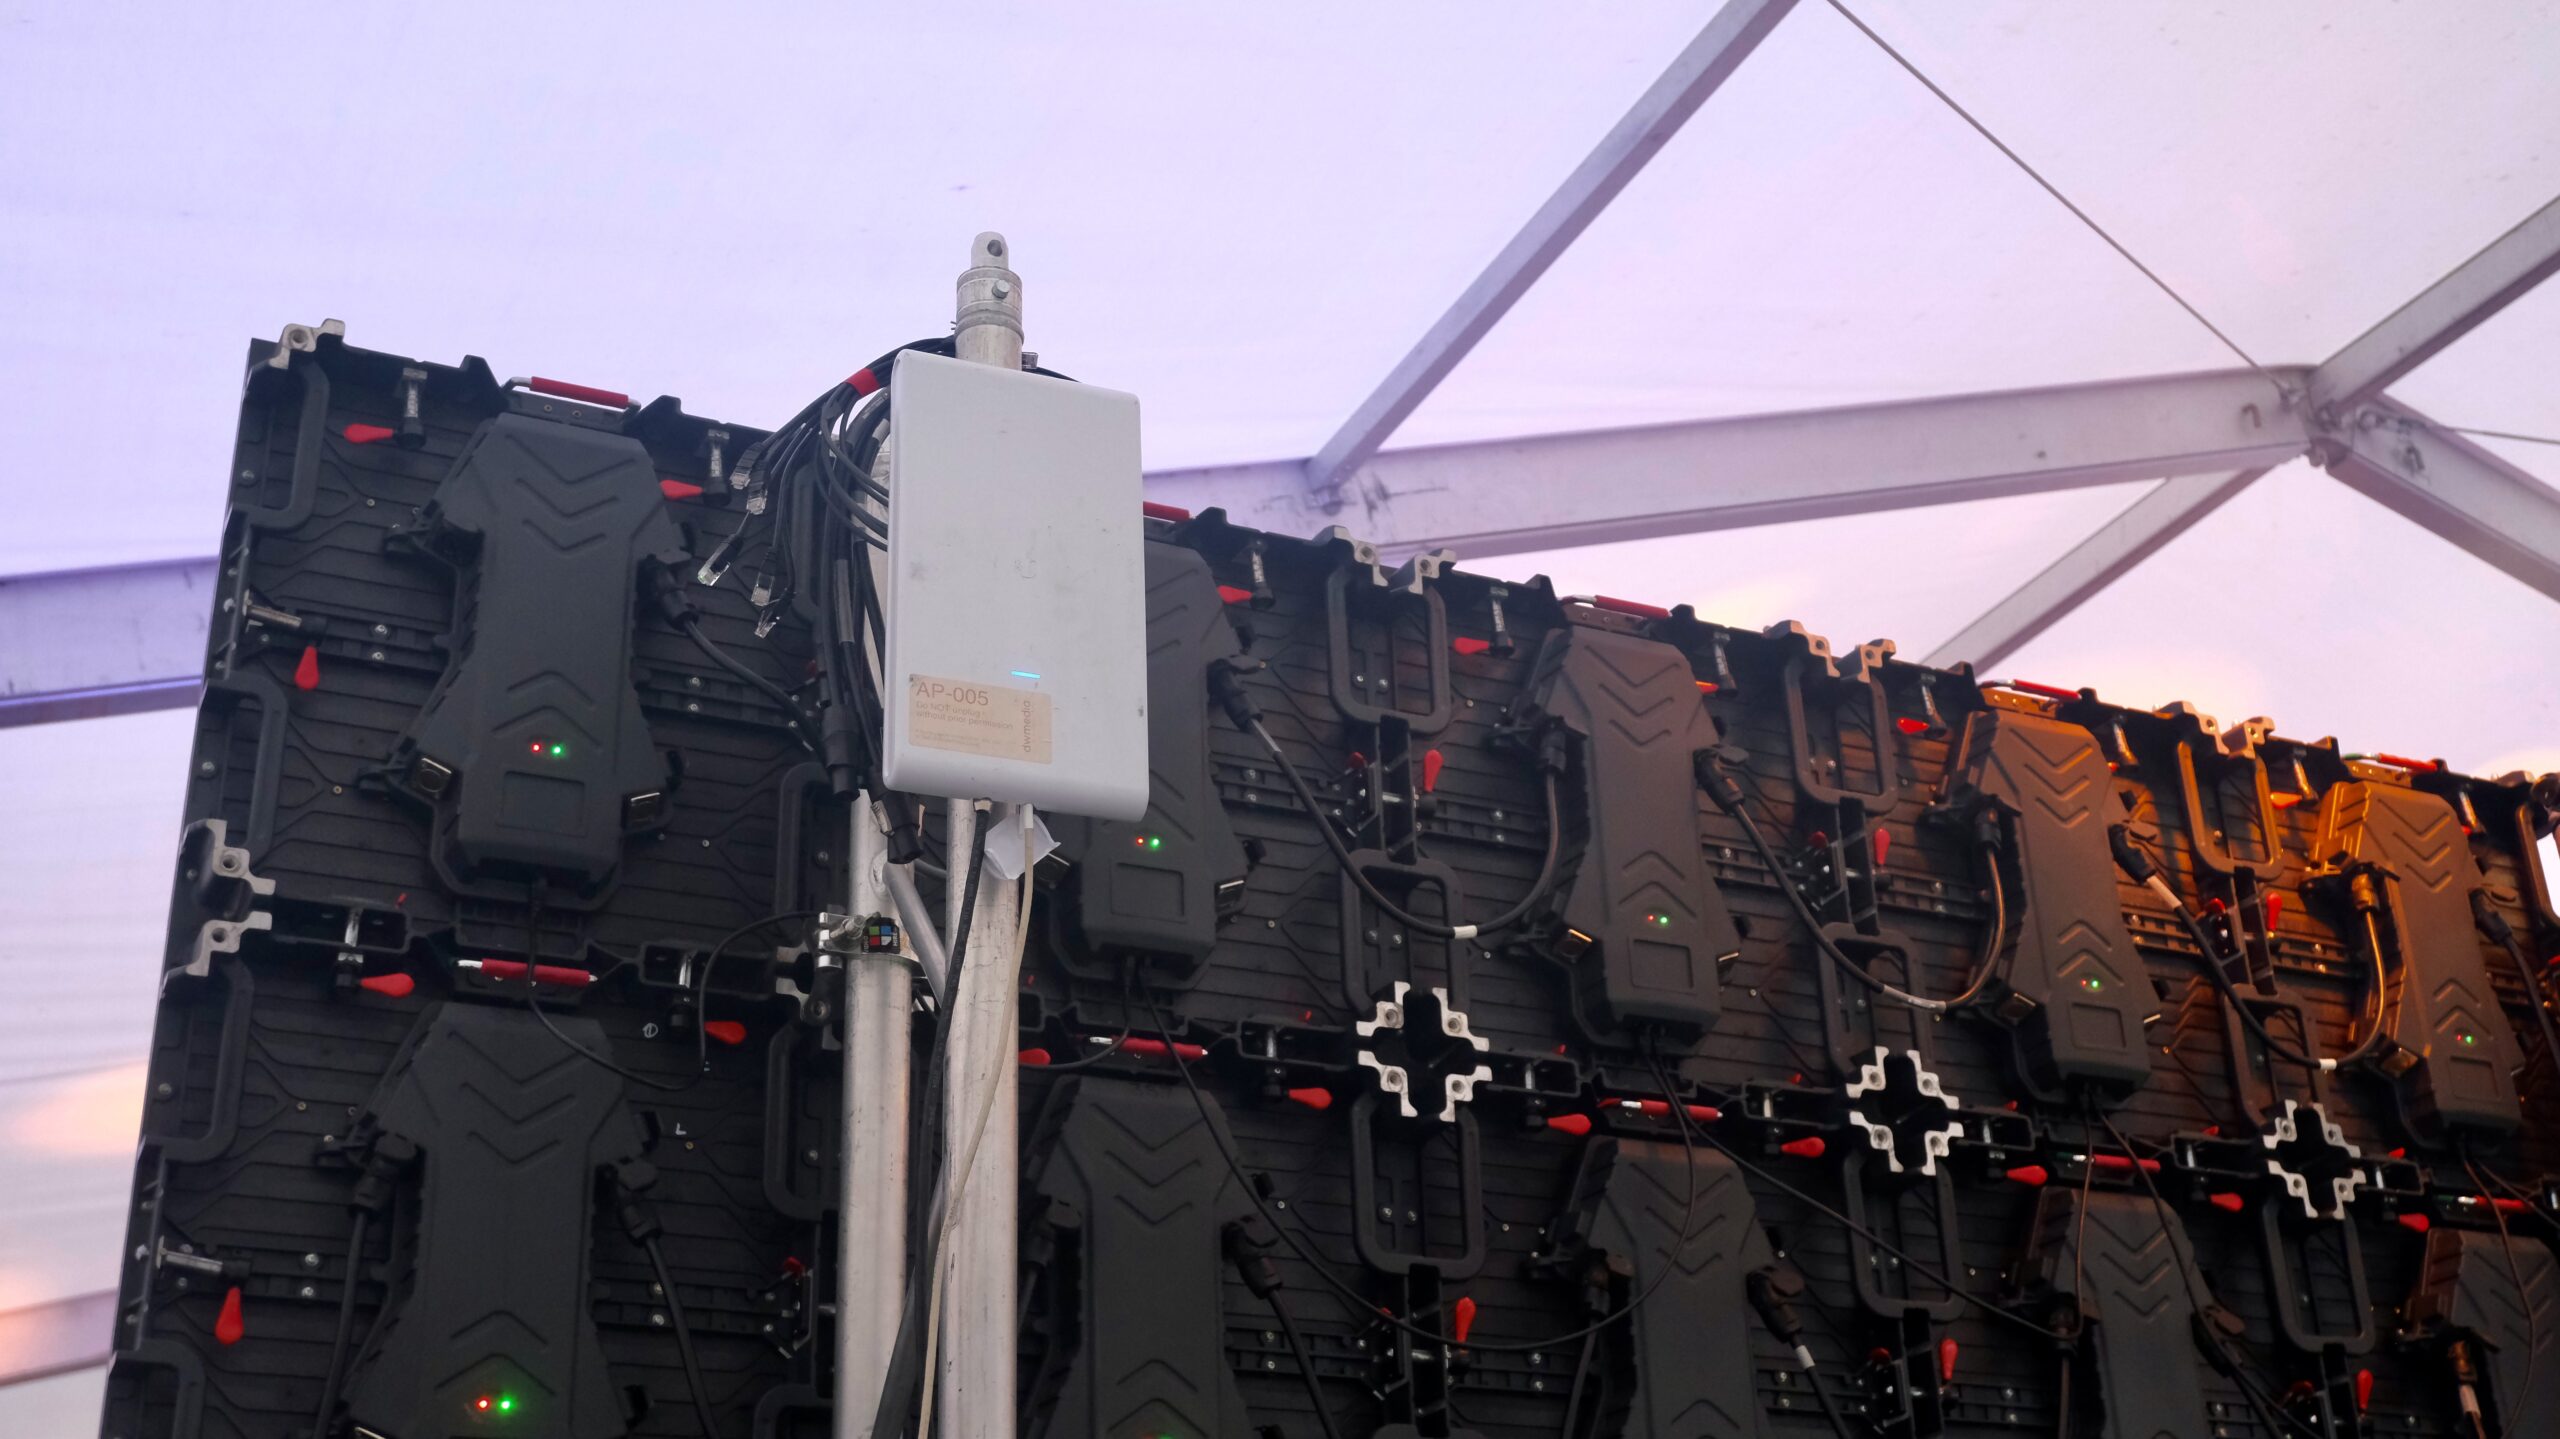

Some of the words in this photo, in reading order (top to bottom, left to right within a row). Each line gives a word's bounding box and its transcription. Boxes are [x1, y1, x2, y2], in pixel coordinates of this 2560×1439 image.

[916, 681, 990, 707] AP-005
[931, 703, 951, 713] NOT
[916, 711, 946, 722] without
[947, 715, 966, 724] prior
[968, 718, 1014, 730] permission
[1021, 699, 1034, 753] dwmedia
